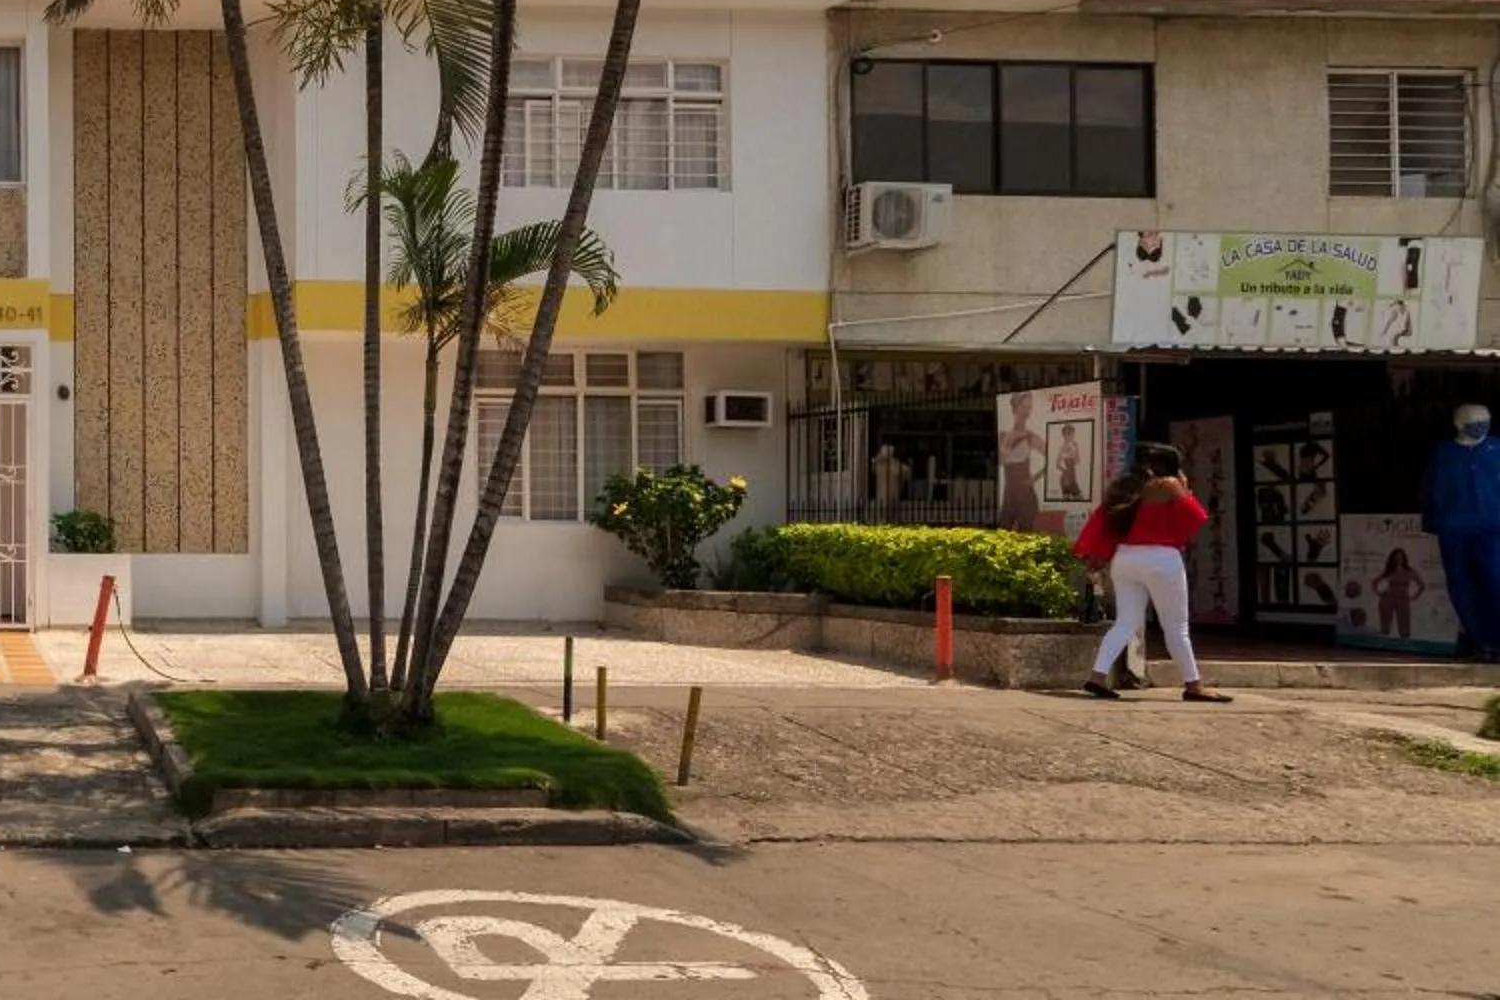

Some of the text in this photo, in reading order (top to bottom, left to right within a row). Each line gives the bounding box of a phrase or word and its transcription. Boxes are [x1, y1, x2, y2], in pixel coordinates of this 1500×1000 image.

[1221, 239, 1378, 272] LA CASA DE LA SALUD
[1240, 282, 1257, 294] Un
[1260, 282, 1301, 295] tributo
[1314, 283, 1325, 295] la
[1329, 283, 1354, 296] vida
